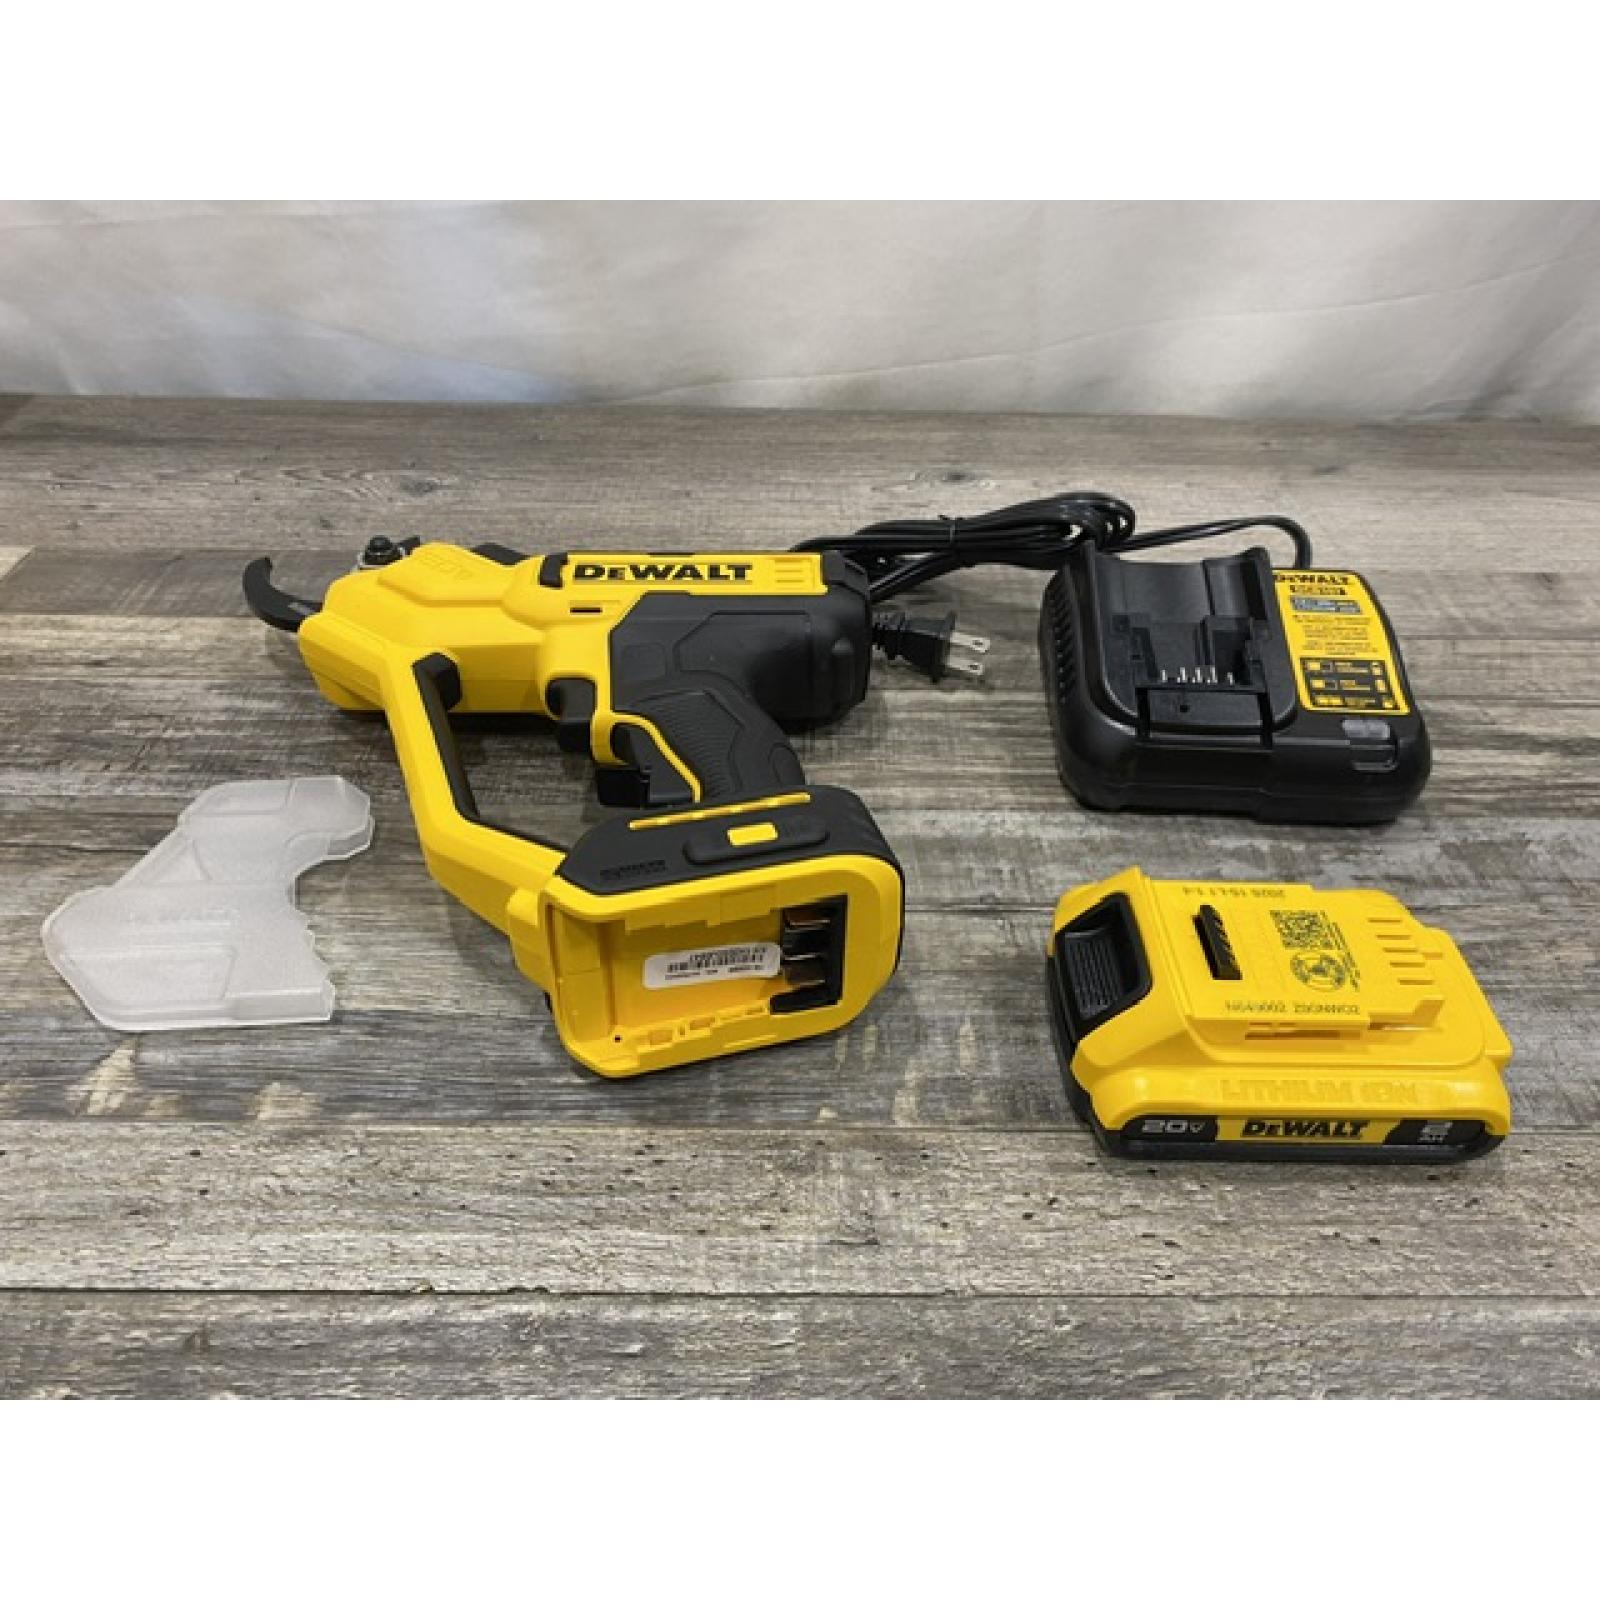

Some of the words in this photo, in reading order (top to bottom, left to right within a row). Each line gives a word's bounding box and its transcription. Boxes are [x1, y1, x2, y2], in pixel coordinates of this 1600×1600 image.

[573, 564, 752, 581] DEWALT
[1220, 1079, 1353, 1103] LITHIUM
[1240, 1119, 1370, 1137] DEWALT
